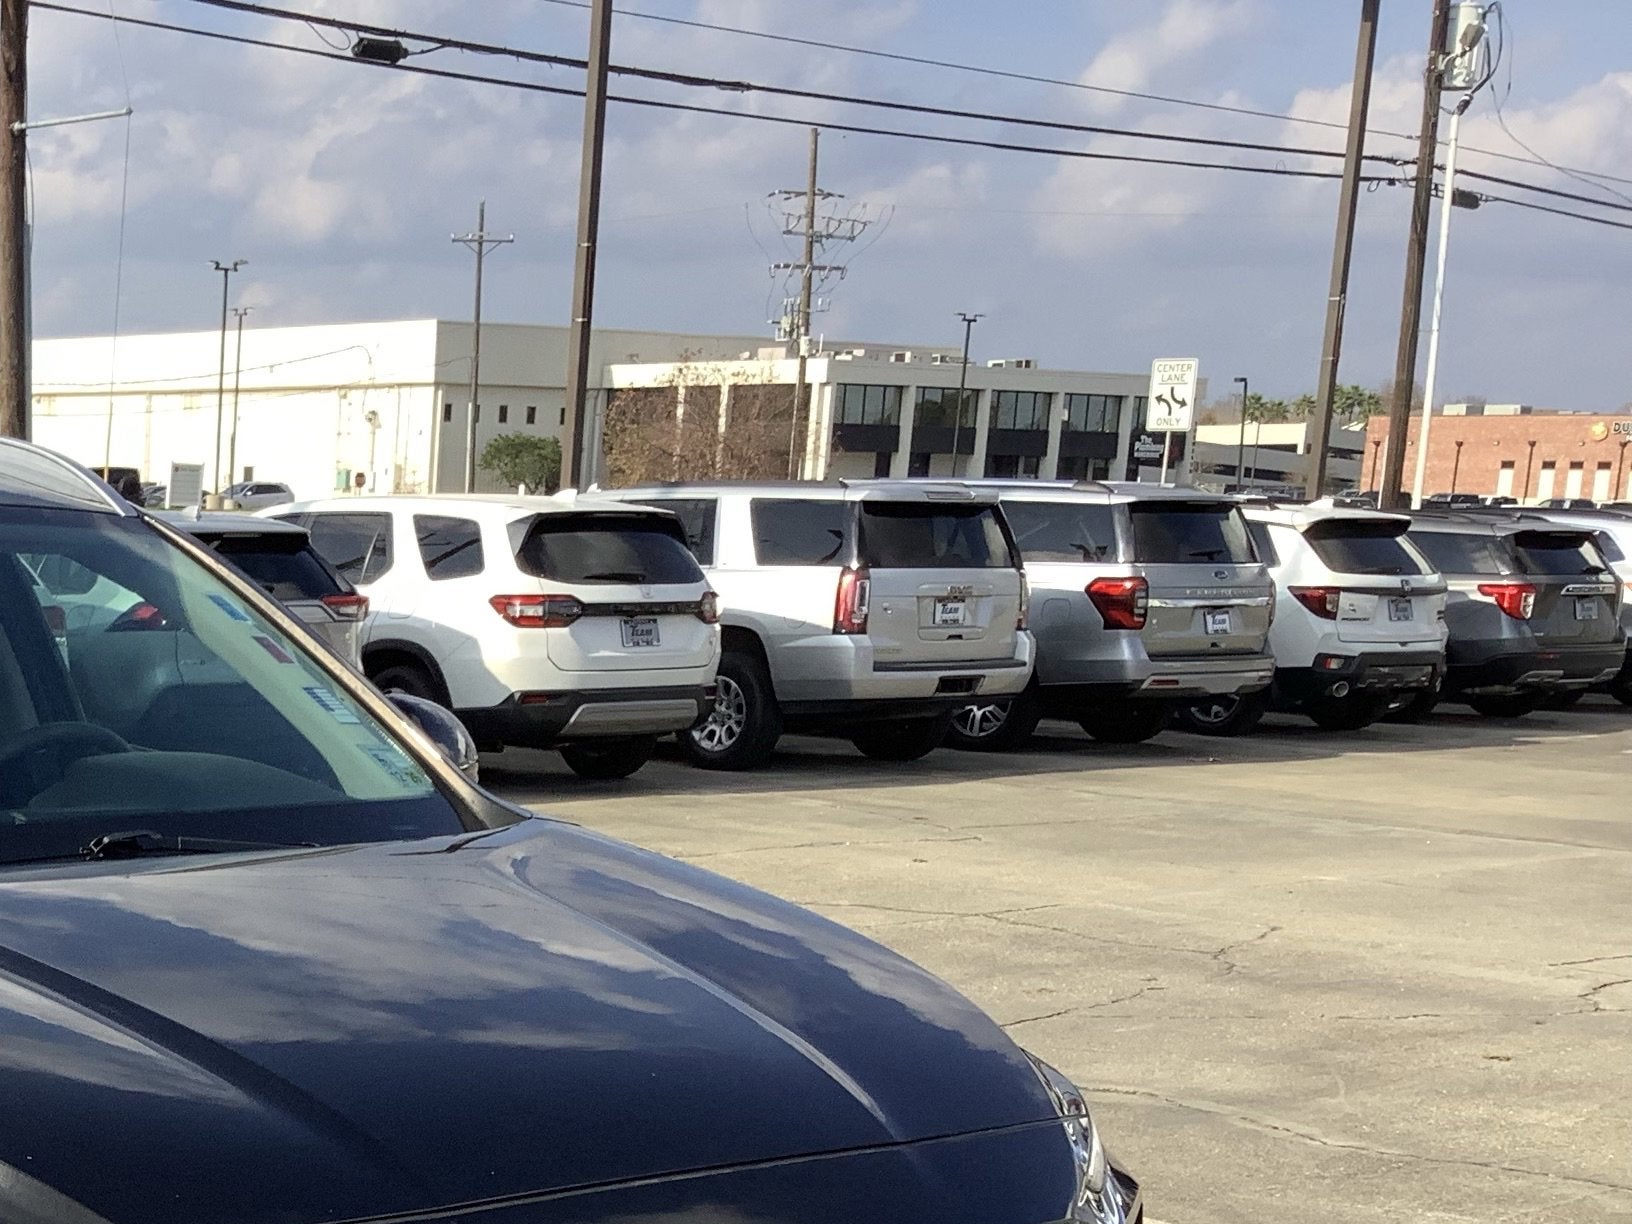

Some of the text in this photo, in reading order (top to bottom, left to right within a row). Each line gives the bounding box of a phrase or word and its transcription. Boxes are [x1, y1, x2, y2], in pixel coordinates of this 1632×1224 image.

[1156, 363, 1193, 373] CENTER
[1161, 373, 1187, 383] LANE
[1156, 417, 1181, 427] ONLY
